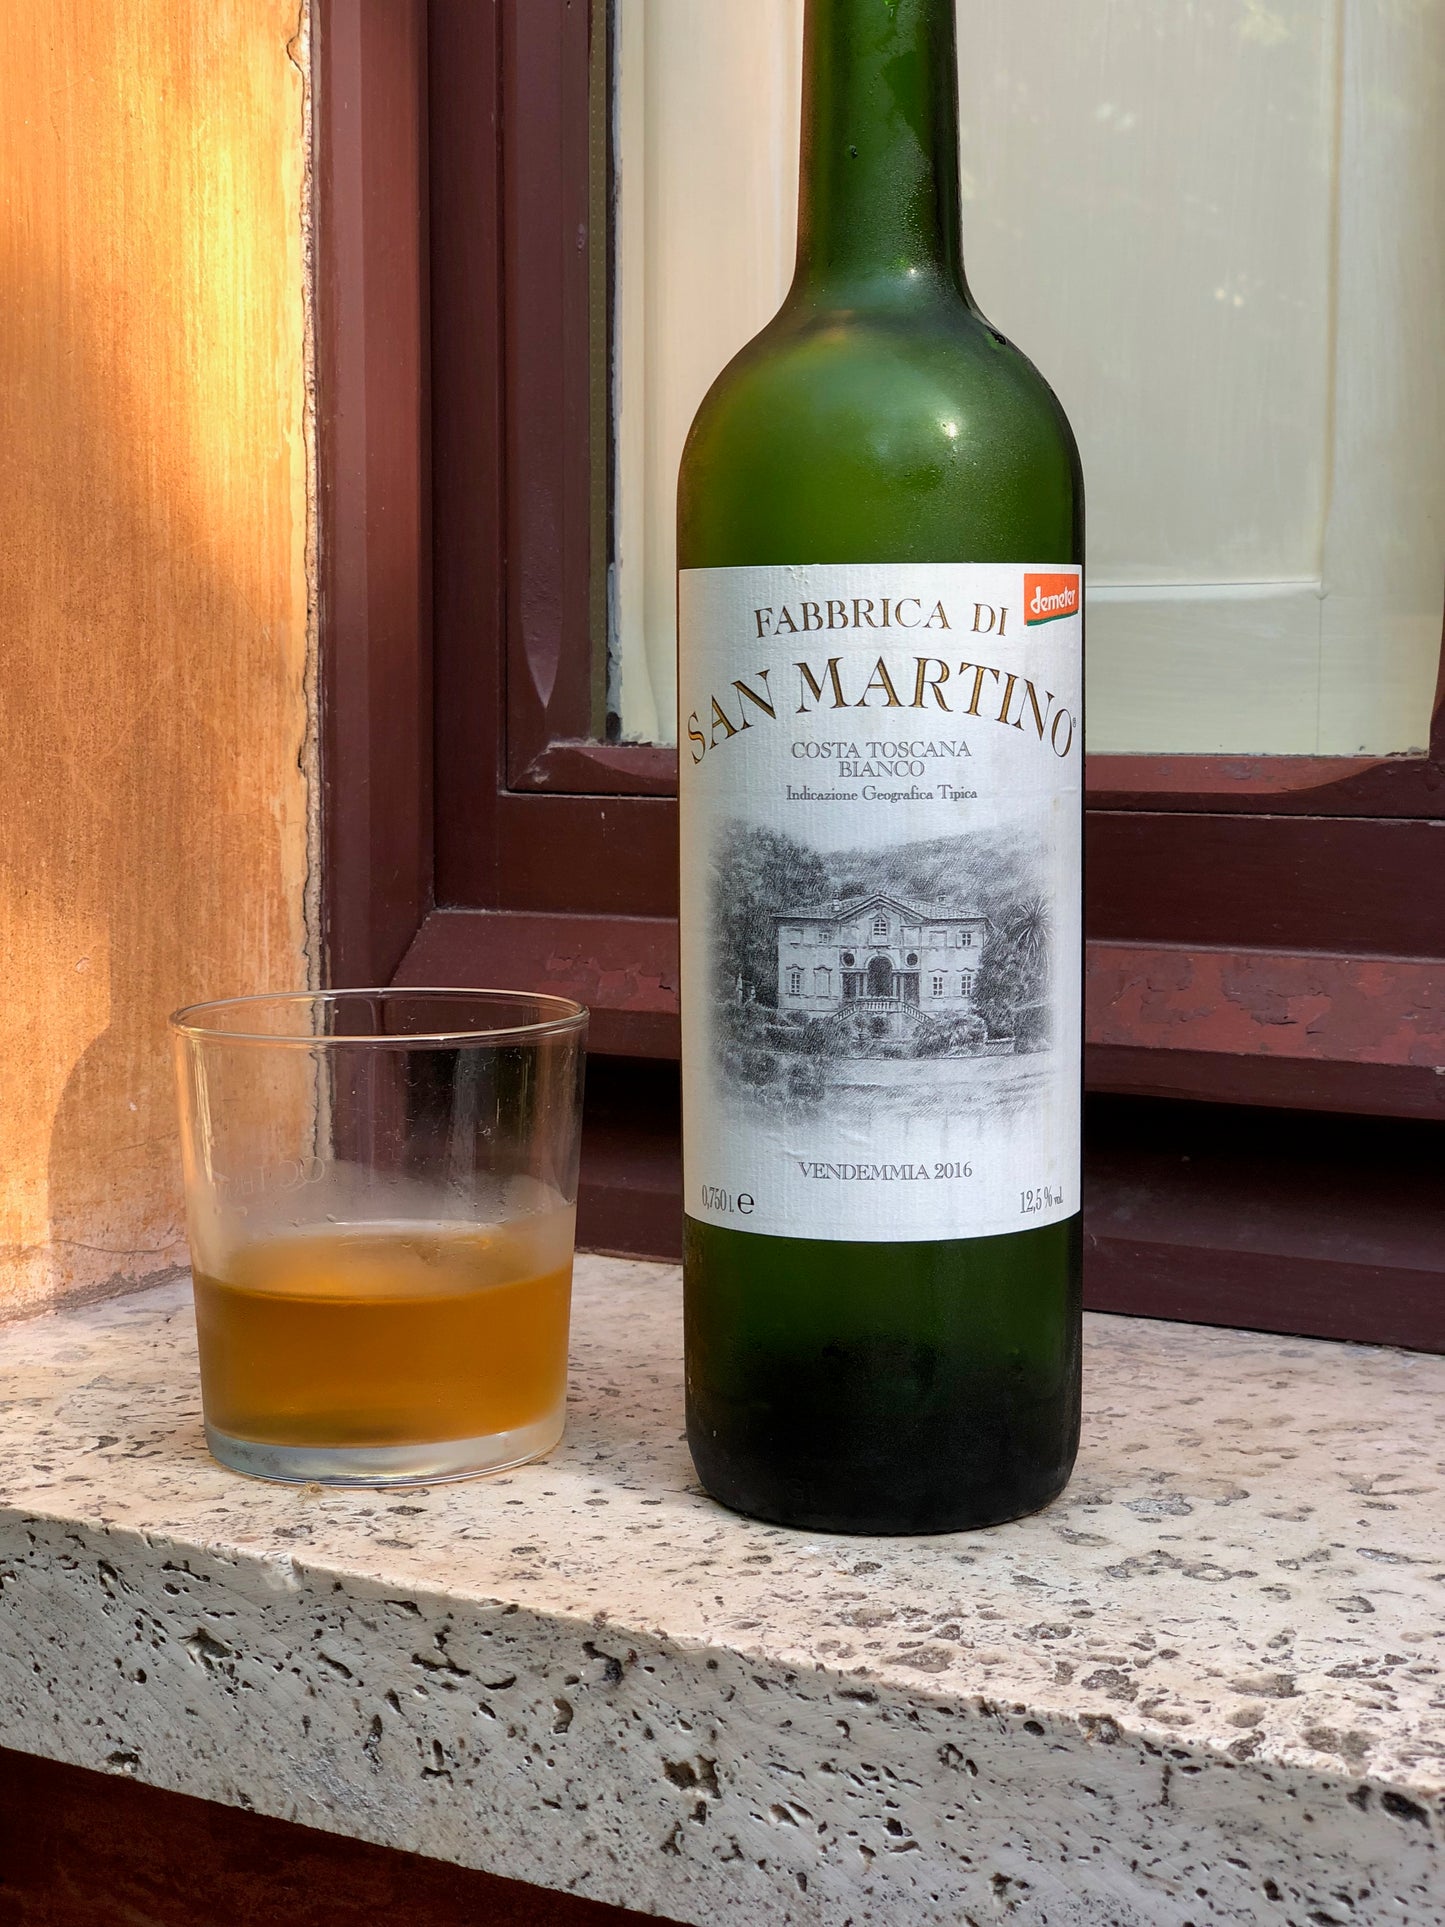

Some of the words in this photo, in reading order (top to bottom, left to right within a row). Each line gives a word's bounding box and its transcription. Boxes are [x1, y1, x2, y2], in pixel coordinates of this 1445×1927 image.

[1030, 585, 1076, 614] demeter
[754, 598, 952, 638] FABBRICA
[971, 603, 1009, 636] DI
[687, 669, 778, 765] SAN
[792, 656, 1073, 758] MARTINO
[791, 741, 861, 759] COSTA
[866, 740, 972, 758] TOSCANA
[838, 760, 925, 778] BIANCO
[786, 785, 858, 801] Indicazione
[862, 785, 933, 803] Geografica
[937, 784, 978, 801] Tipica
[799, 1161, 930, 1180] VENDEMMIA
[934, 1161, 973, 1179] 2016
[701, 1184, 727, 1211] 0,750
[1020, 1188, 1042, 1213] 12,5
